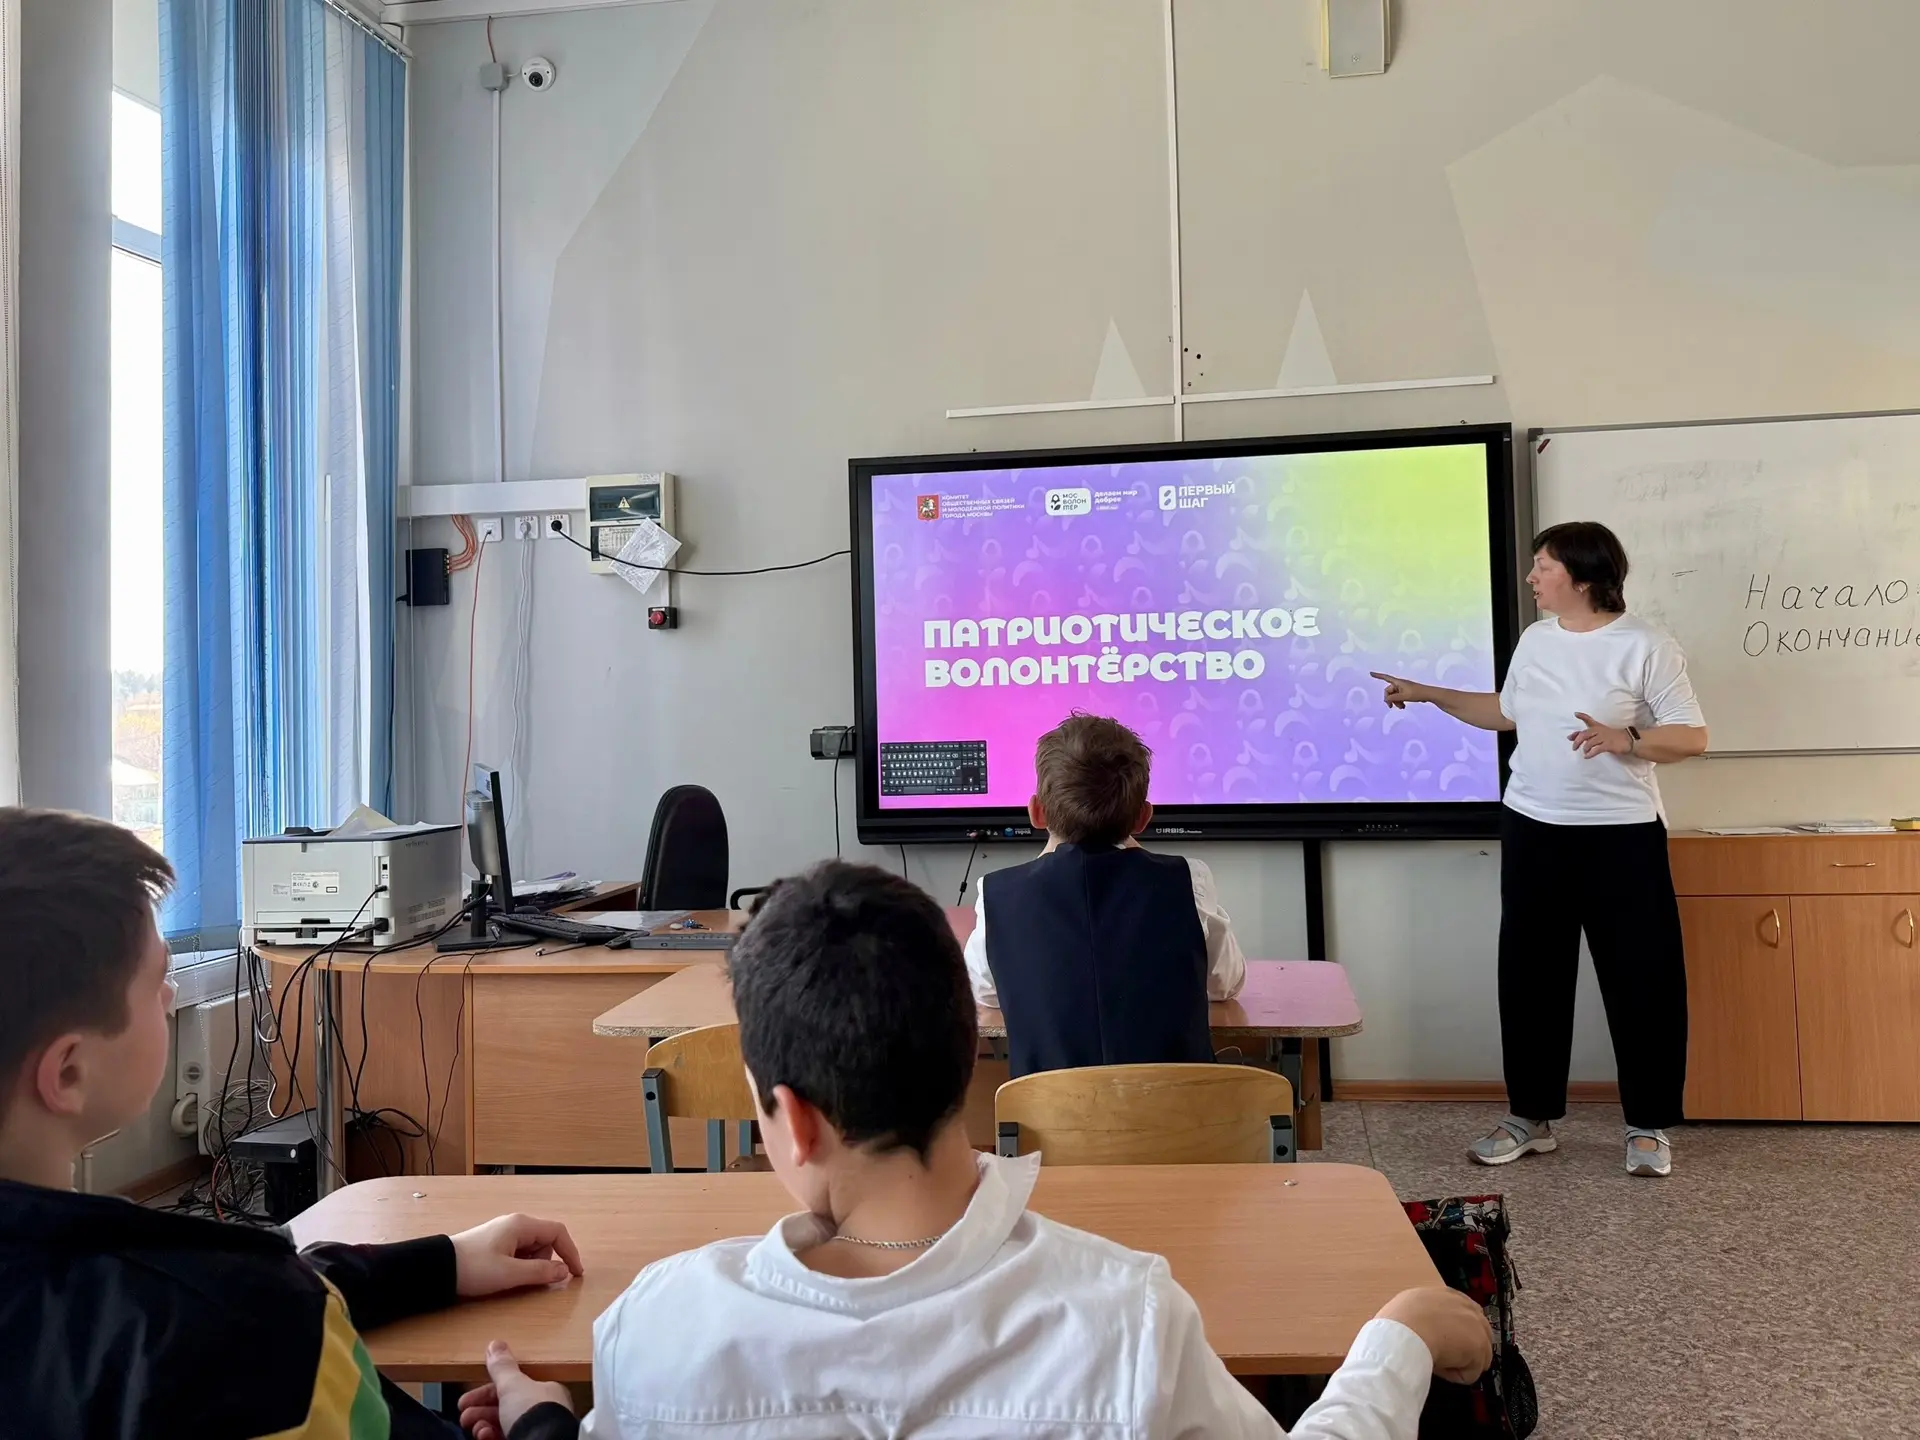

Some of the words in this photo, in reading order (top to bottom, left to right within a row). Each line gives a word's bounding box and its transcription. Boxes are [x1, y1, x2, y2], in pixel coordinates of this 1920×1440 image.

[1179, 481, 1235, 497] ПЕРВЫЙ
[942, 499, 991, 507] ОБЩЕСТВЕННЫХ
[1179, 497, 1208, 508] ШАГ
[923, 607, 1321, 648] ПАТРИОТИЧЕСКОЕ
[924, 646, 1265, 688] ВОЛОНТЁРСТВО
